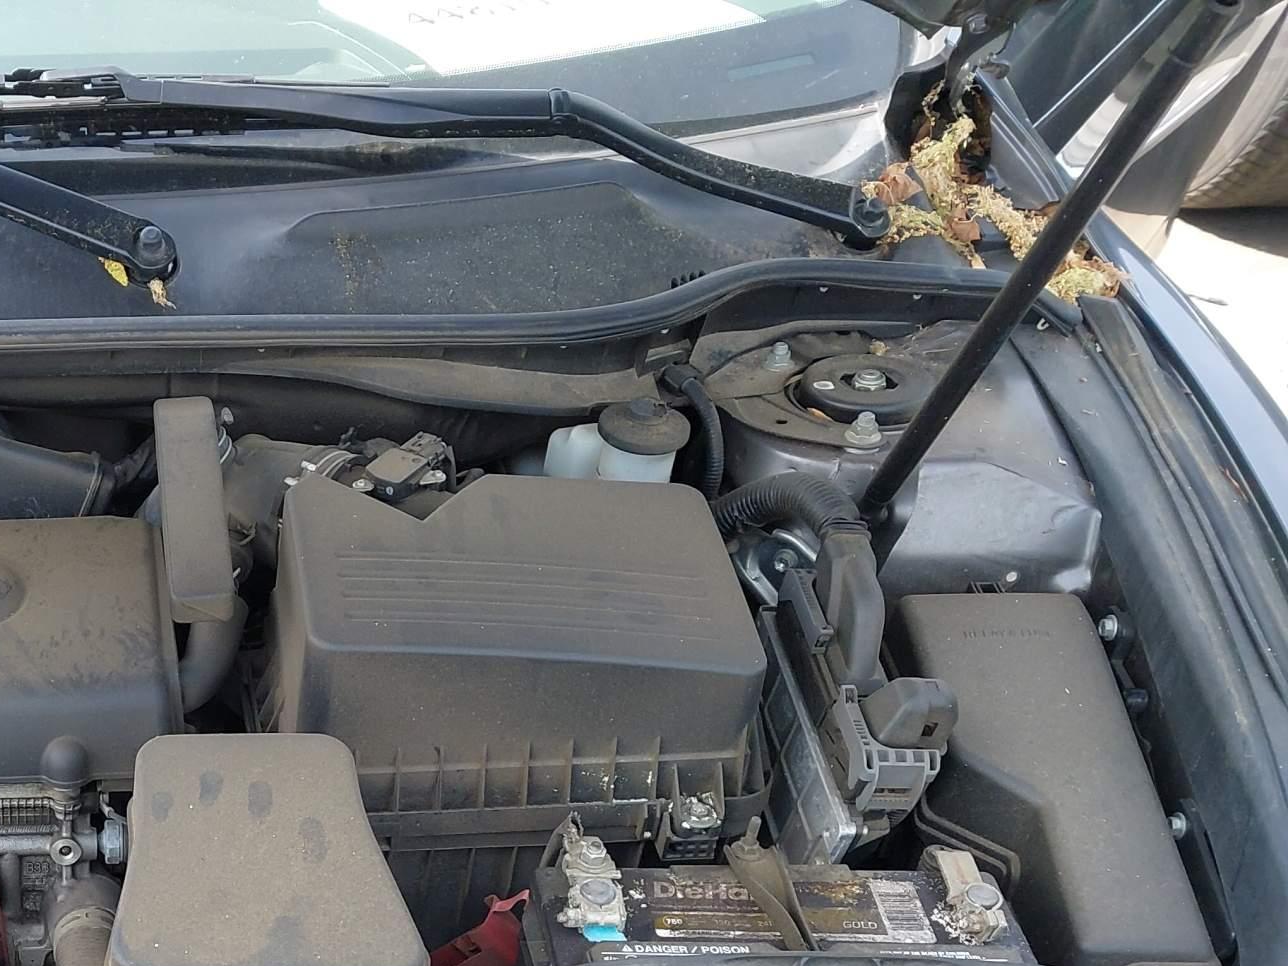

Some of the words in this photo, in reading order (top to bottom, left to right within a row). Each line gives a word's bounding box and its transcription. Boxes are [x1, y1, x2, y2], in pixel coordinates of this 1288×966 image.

[843, 920, 878, 930] GOLD
[634, 944, 688, 955] DANGER
[700, 945, 751, 955] POISON
